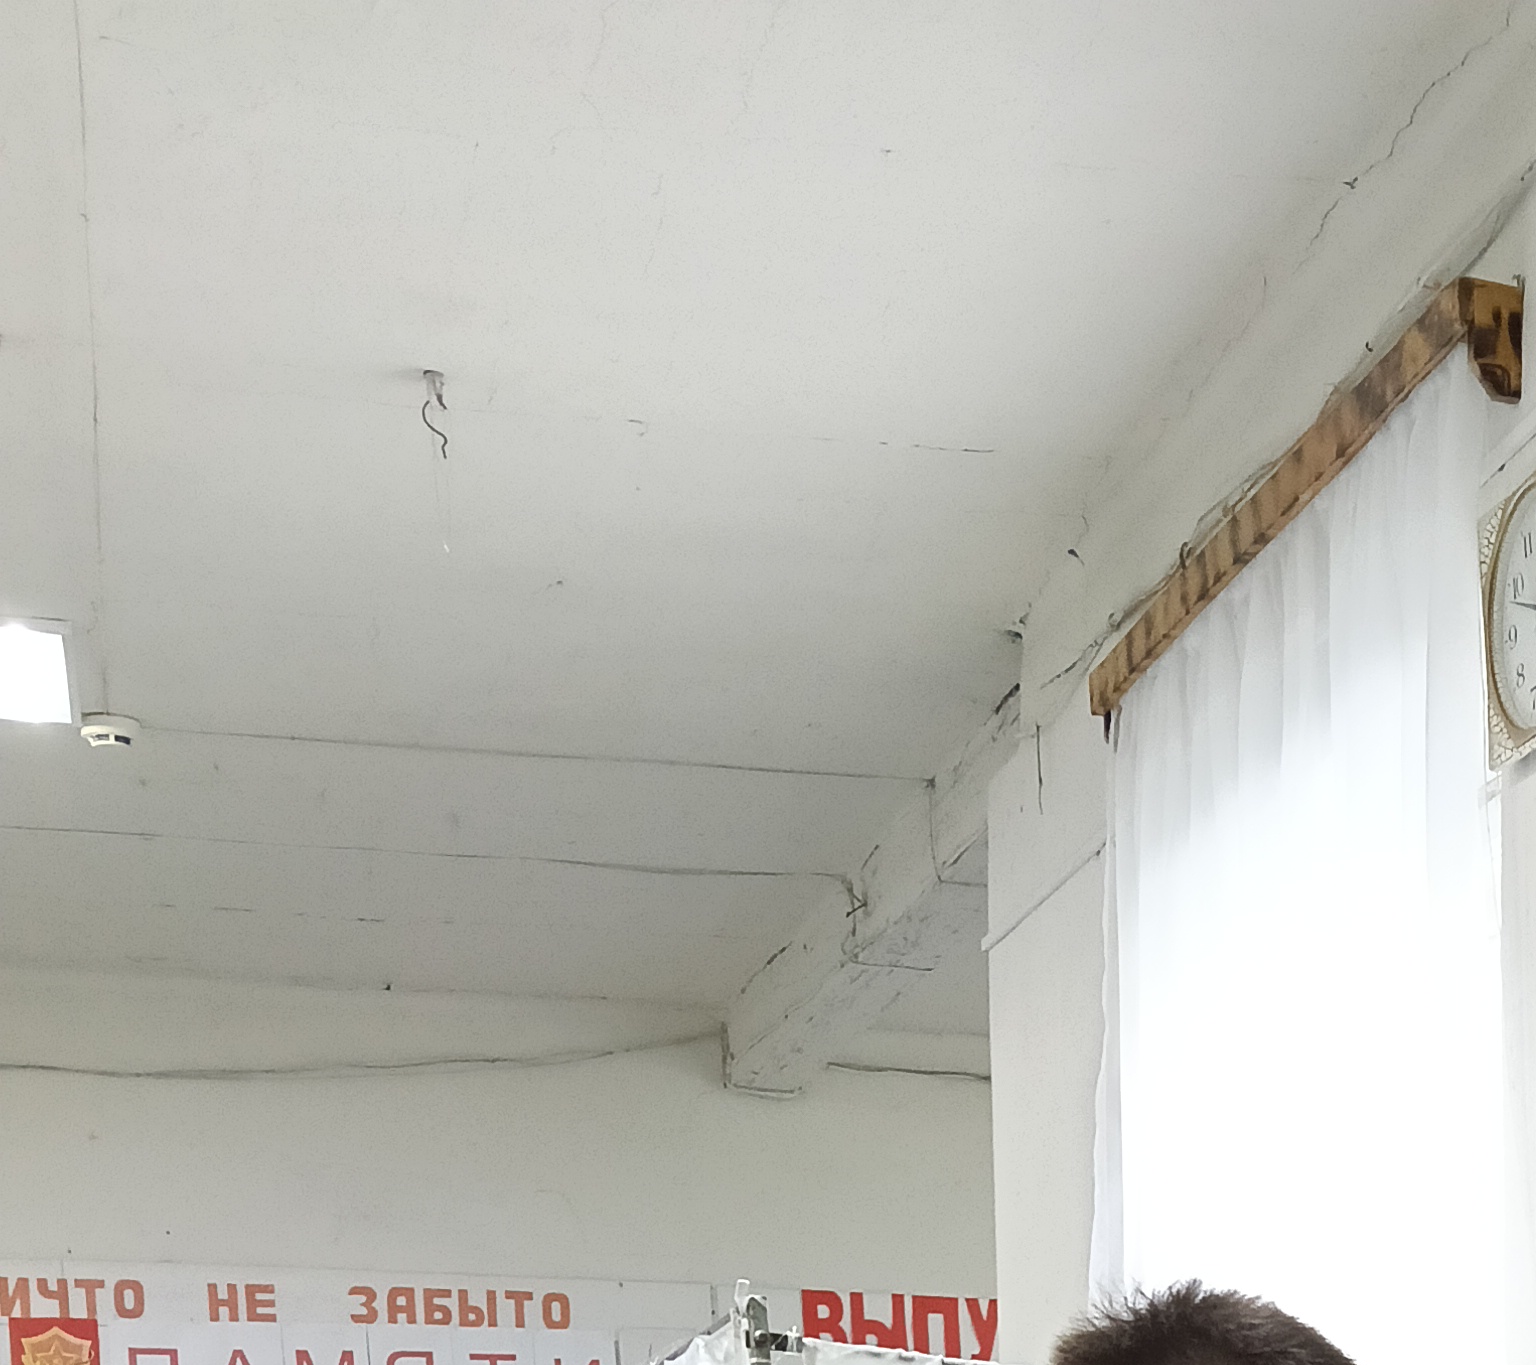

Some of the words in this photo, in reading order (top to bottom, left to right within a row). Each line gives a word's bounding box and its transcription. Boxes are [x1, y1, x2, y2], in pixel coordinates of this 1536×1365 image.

[1521, 531, 1534, 559] 11
[1511, 572, 1525, 601] 10
[1508, 624, 1518, 650] 9
[1516, 662, 1526, 689] 8
[207, 1283, 277, 1323] НЕ
[348, 1286, 571, 1330] ЗАБЫТО
